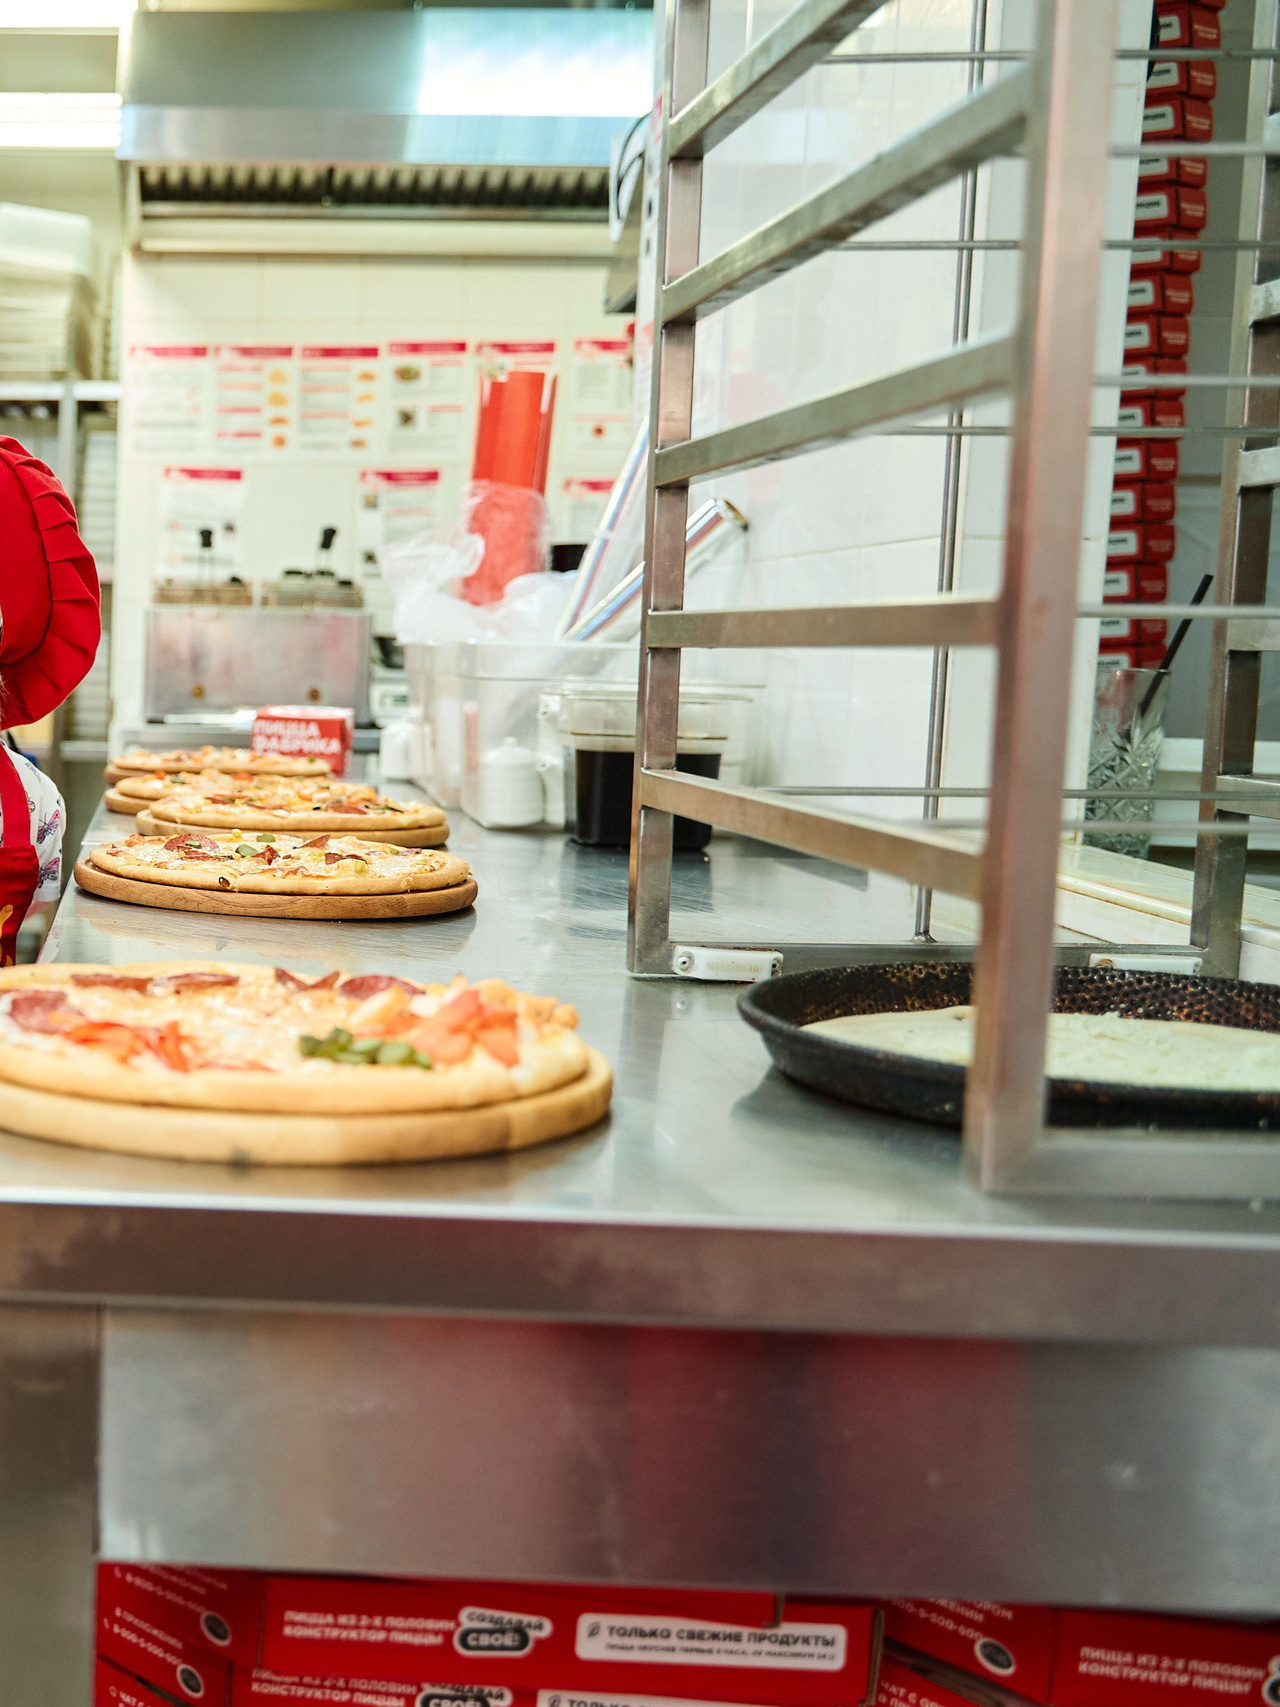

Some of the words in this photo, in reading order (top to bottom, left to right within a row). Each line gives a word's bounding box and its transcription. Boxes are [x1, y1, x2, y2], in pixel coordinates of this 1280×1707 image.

[253, 719, 320, 737] ПИЦЦА
[252, 735, 341, 755] ФАБРИКА
[284, 1610, 335, 1625] ПИЦЦА
[282, 1624, 388, 1643] КОНСТРУКТОР
[607, 1625, 671, 1639] ТОЛЬКО
[676, 1628, 742, 1642] СВЕЖИЕ
[747, 1632, 836, 1647] ПРОДУКТЫ
[1079, 1647, 1133, 1663] ПИЦЦА
[1137, 1653, 1158, 1667] ИЗ
[1187, 1659, 1266, 1680] ПОЛОВИН
[1078, 1660, 1190, 1686] КОНСТРУКТОР
[1192, 1675, 1252, 1695] ПИЦЦЫ
[251, 1682, 351, 1703] КОНСТРУКТОР
